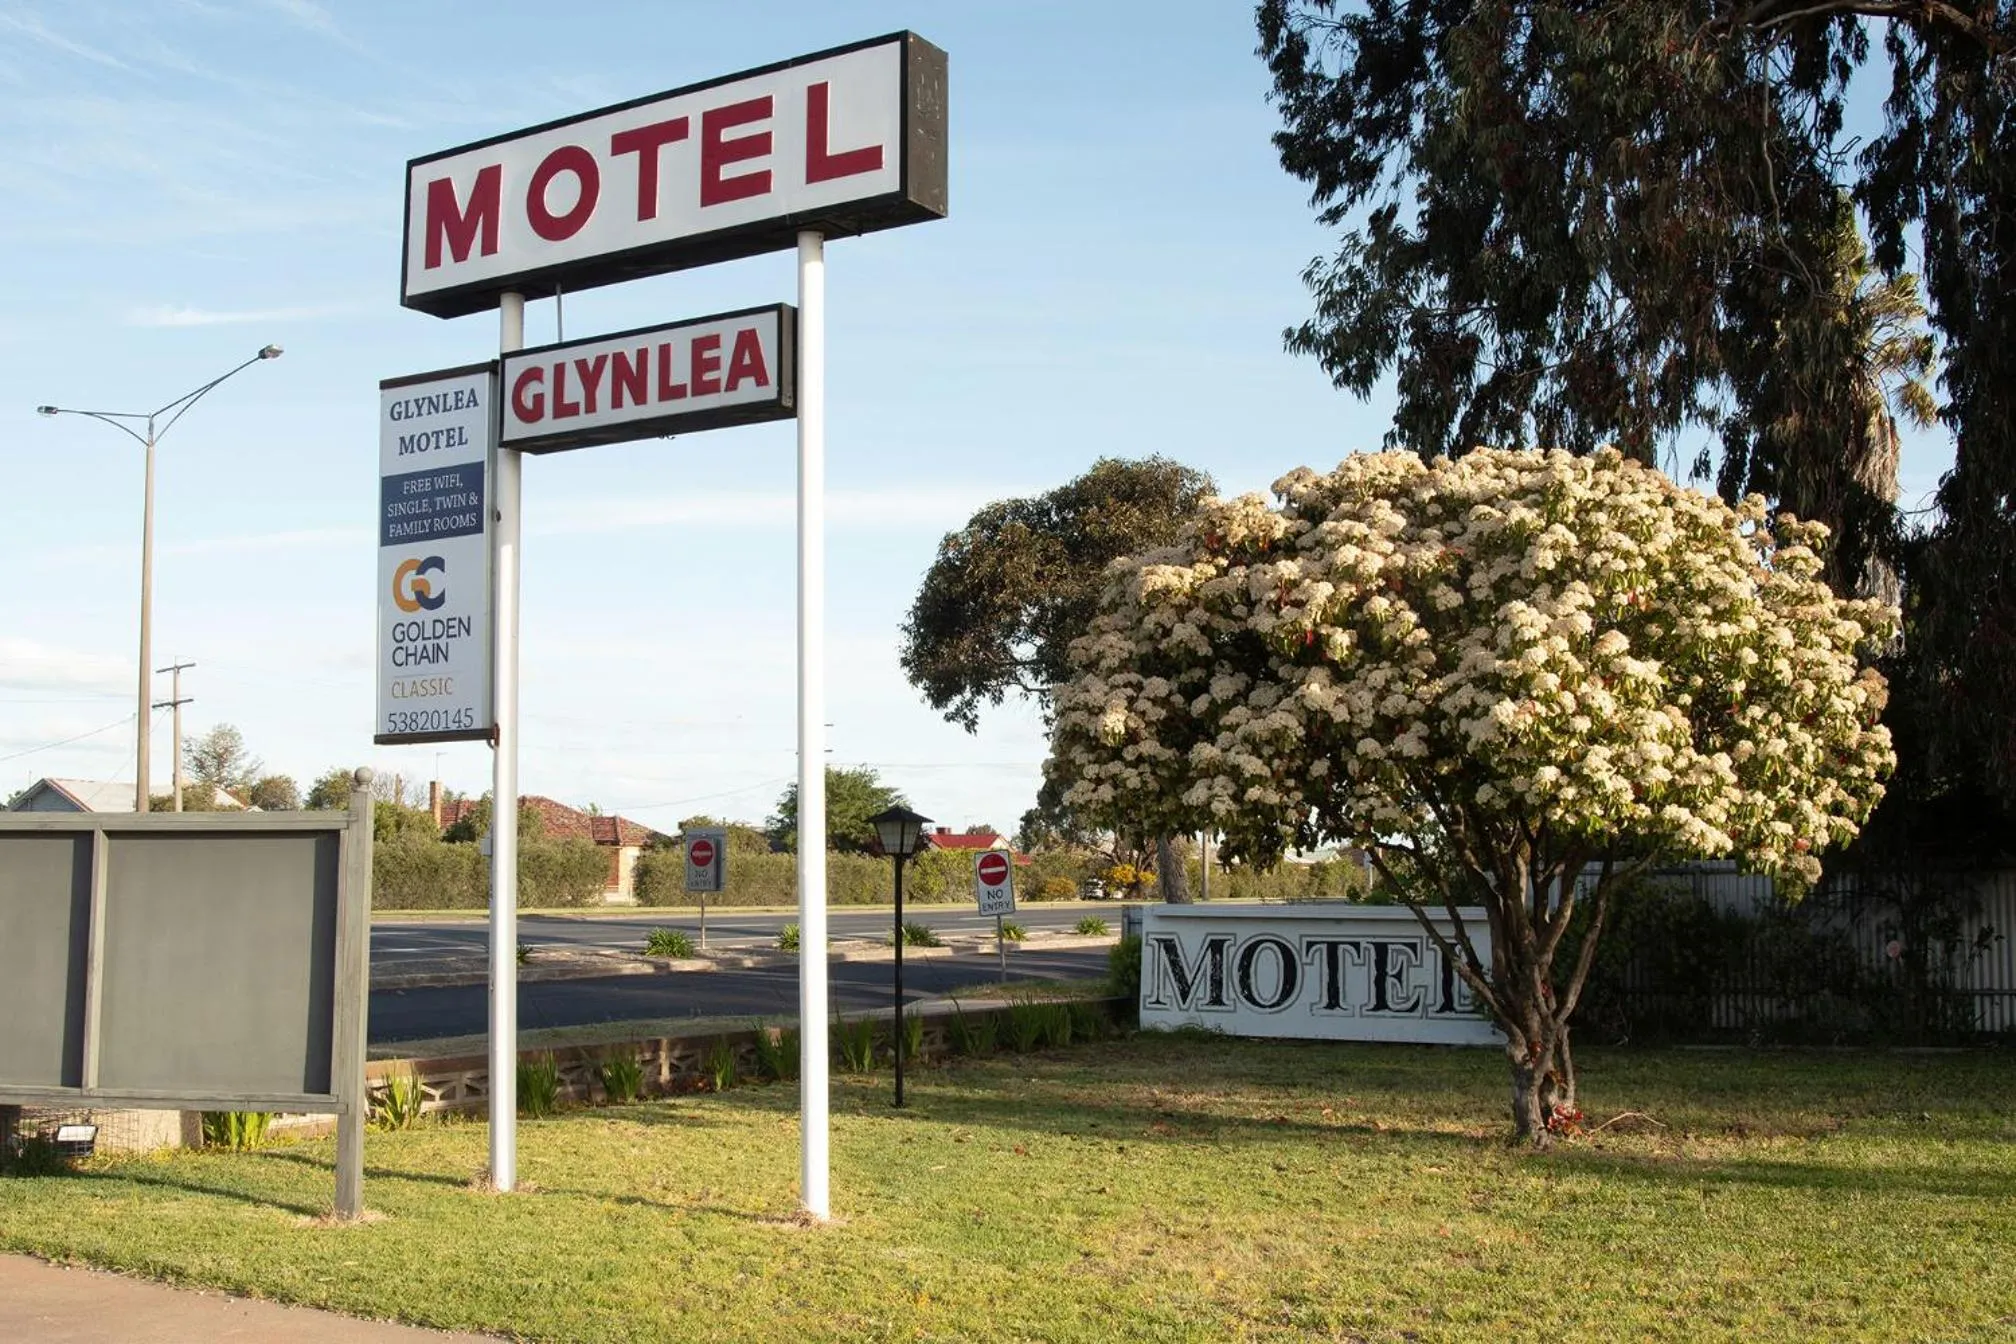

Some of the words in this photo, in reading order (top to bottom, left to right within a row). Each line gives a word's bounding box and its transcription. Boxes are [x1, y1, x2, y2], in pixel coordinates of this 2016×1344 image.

[424, 81, 884, 270] MOTEL
[511, 327, 771, 424] GLYNLEA
[389, 387, 479, 422] GLYNLEA
[398, 425, 469, 456] MOTEL
[403, 476, 431, 495] FREE
[387, 498, 432, 518] SINGLE,
[435, 493, 467, 511] TWIN
[468, 491, 479, 506] &
[389, 519, 432, 538] FAMILY
[433, 512, 477, 532] ROOMS
[391, 615, 471, 644] GOLDEN
[391, 642, 450, 667] CHAIN
[391, 677, 454, 699] CLASSIC
[387, 707, 474, 734] 53820145
[982, 901, 1010, 912] ENTRY
[987, 889, 1003, 900] NO
